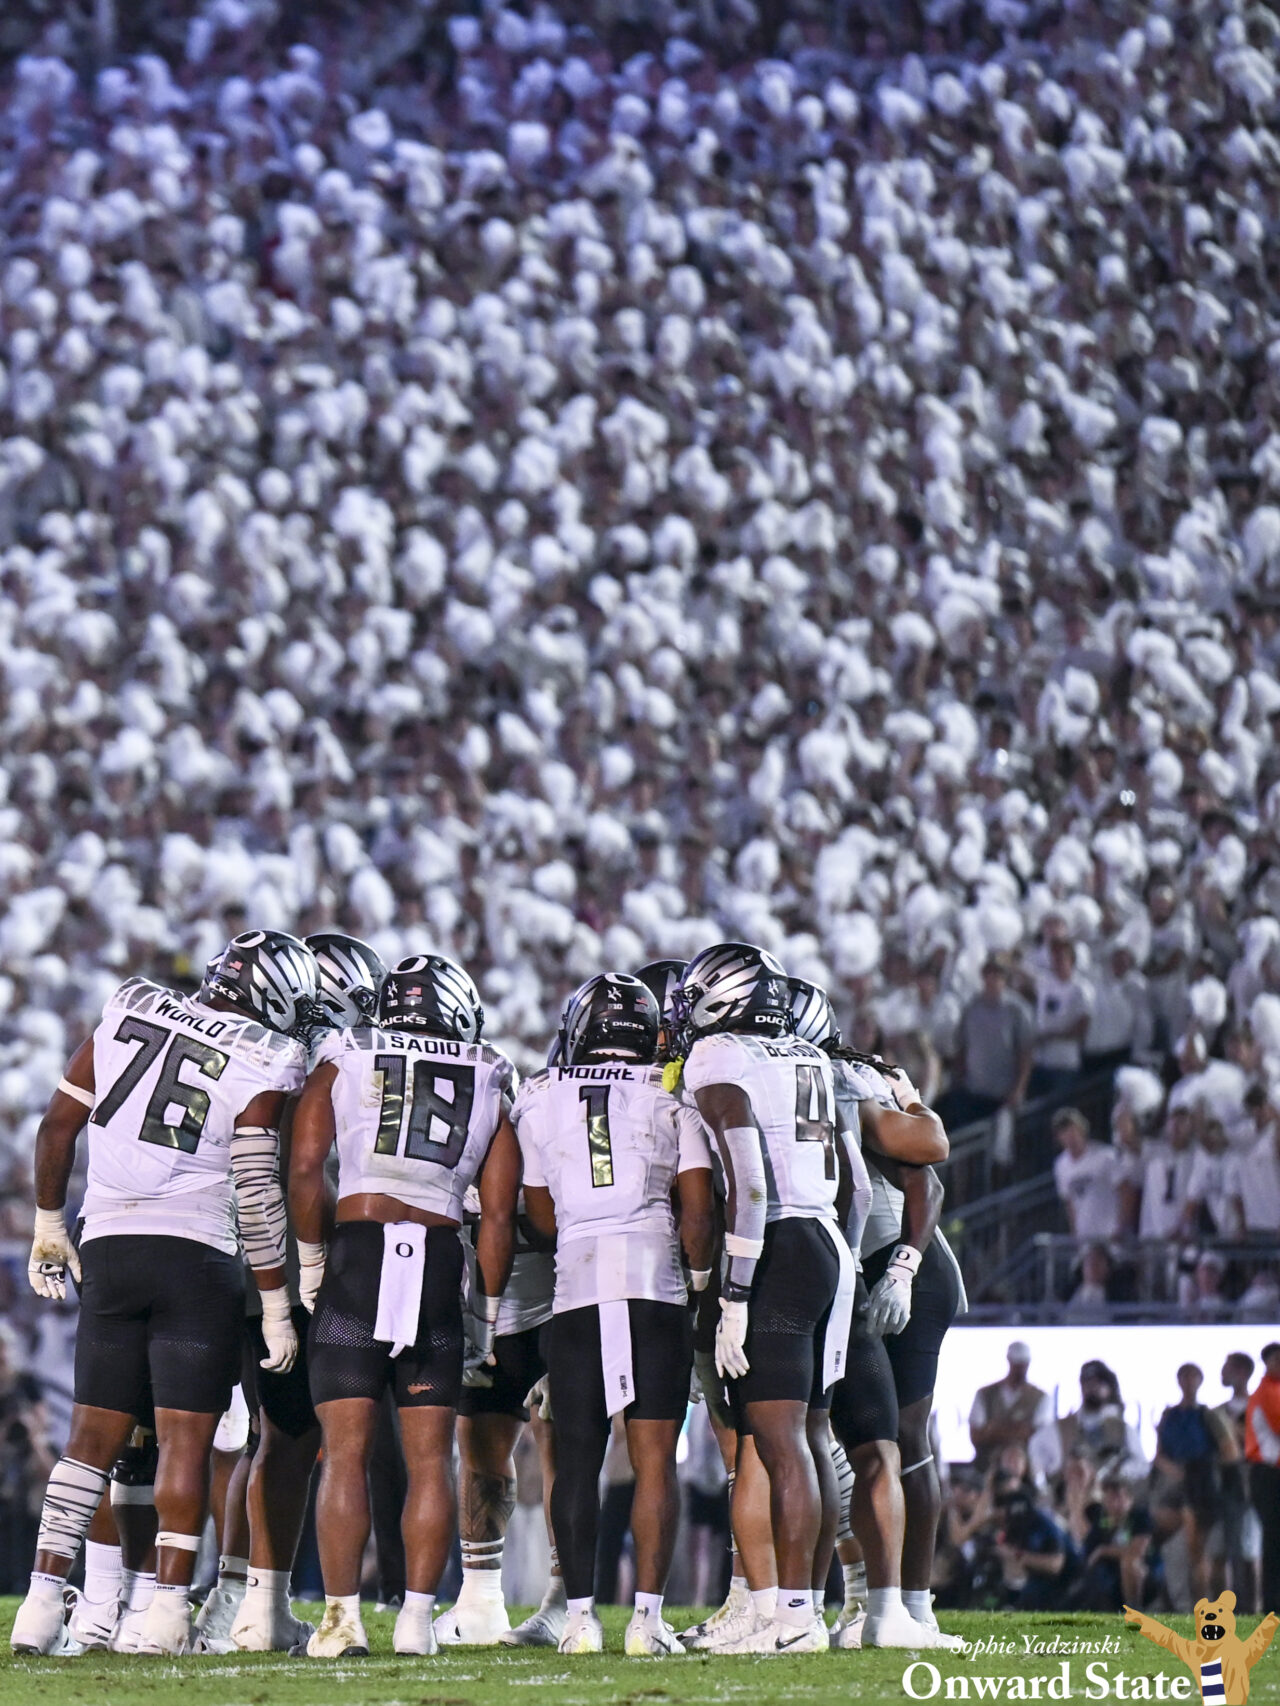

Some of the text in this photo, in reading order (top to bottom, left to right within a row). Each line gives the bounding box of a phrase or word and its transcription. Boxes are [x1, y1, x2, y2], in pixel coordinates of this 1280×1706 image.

[155, 998, 227, 1038] WORLD
[379, 1015, 428, 1029] DUCKS
[612, 1021, 645, 1031] DUCKS
[390, 1035, 461, 1057] SADIQ
[90, 1015, 230, 1155] 76
[558, 1066, 635, 1081] MOORE
[374, 1054, 477, 1169] 18
[795, 1064, 837, 1181] 4
[579, 1085, 614, 1188] 1
